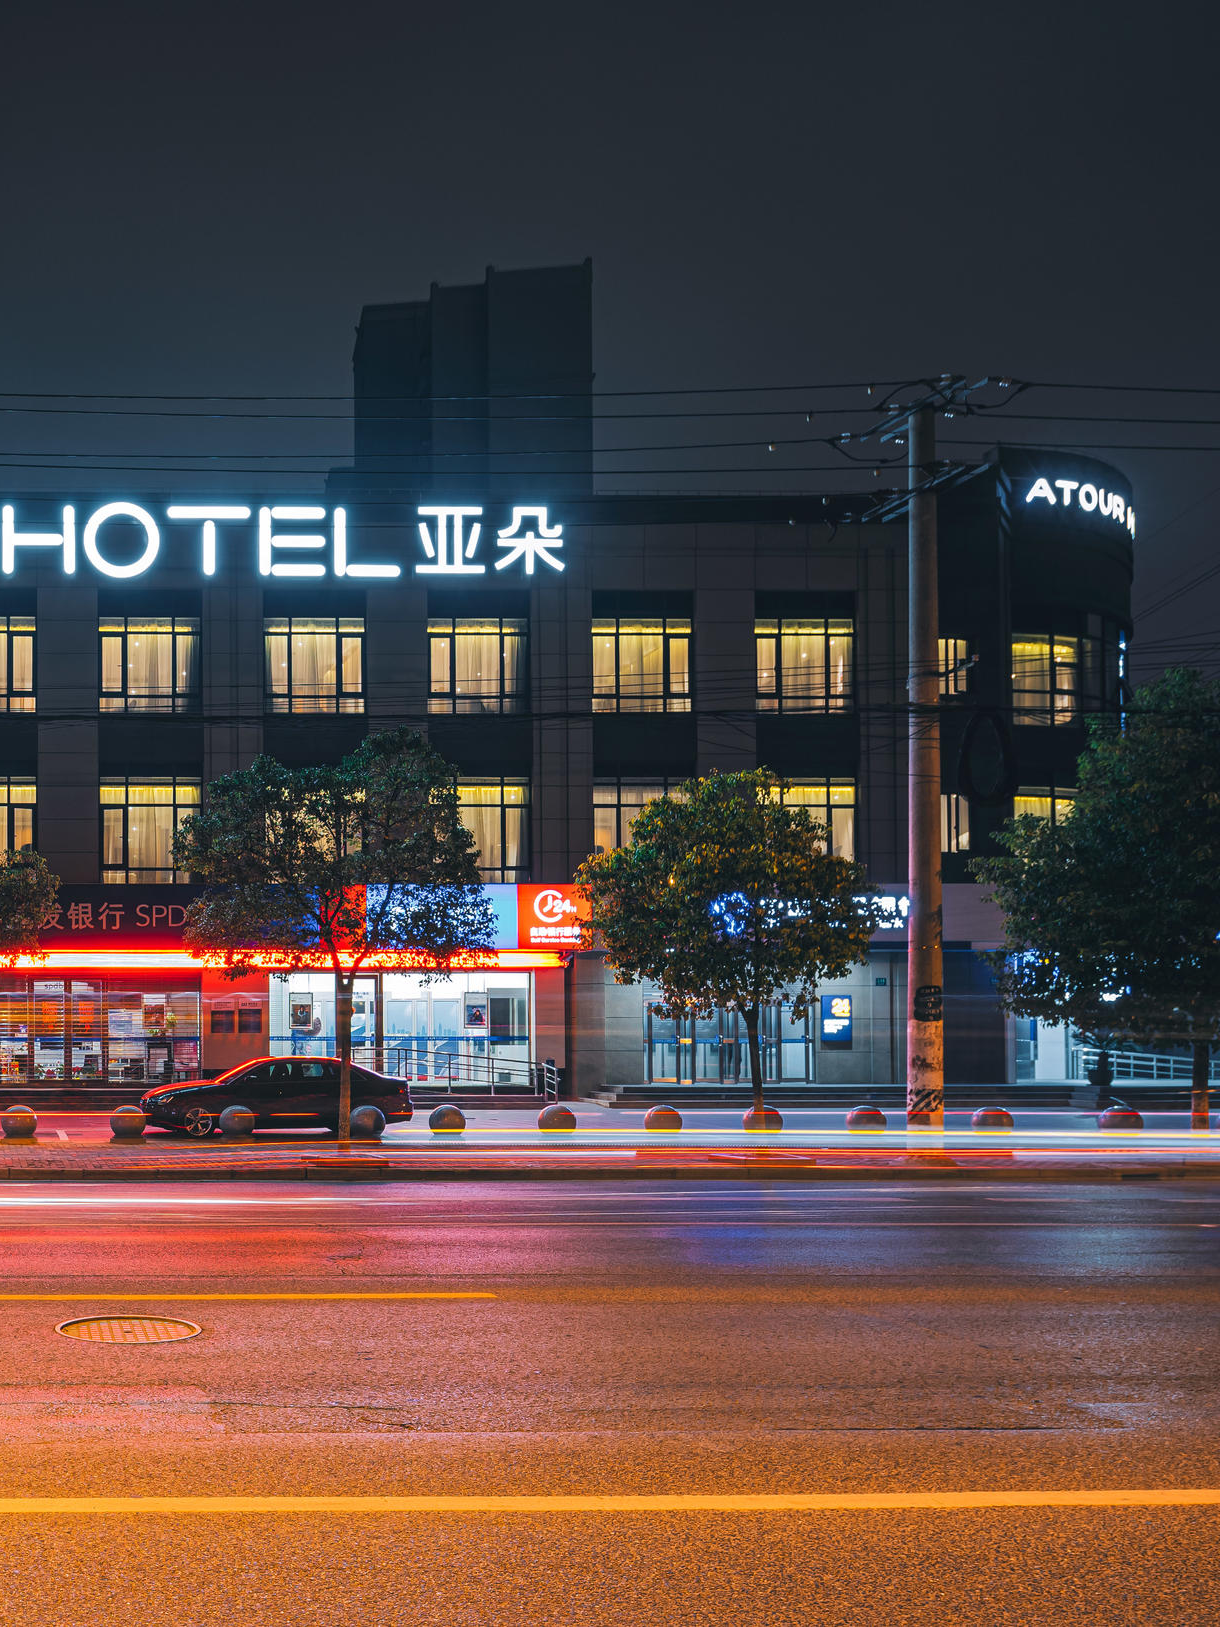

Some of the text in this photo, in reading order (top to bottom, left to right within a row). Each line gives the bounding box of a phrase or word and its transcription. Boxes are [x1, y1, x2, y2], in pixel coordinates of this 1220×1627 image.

[1026, 478, 1125, 523] ATOUR
[1, 501, 401, 578] HOTEL
[415, 506, 565, 574] 亚朵
